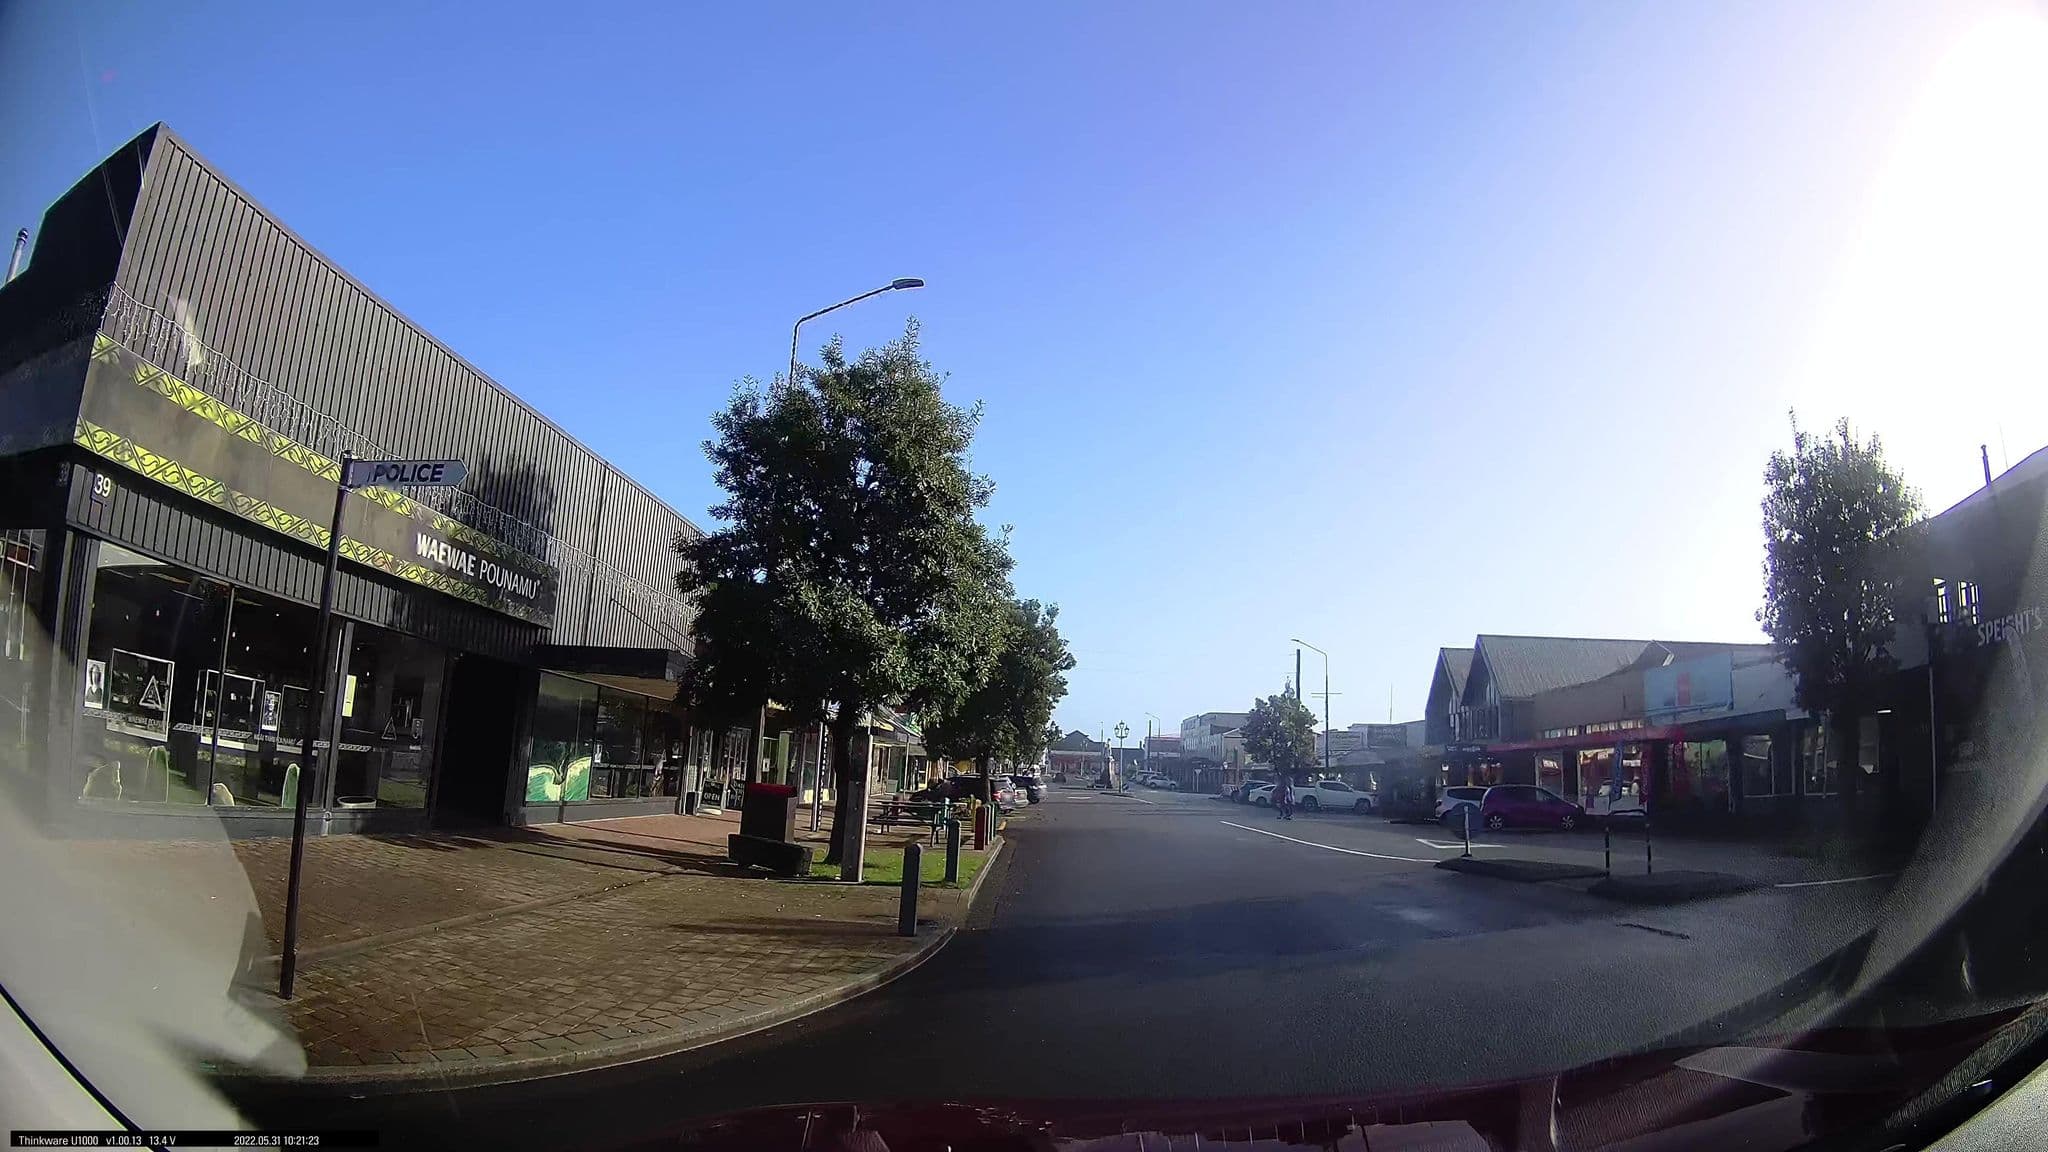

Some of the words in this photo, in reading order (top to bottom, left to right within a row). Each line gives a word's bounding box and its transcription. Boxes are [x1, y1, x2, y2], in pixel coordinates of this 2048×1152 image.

[373, 463, 444, 482] POLICE
[94, 473, 111, 497] 39
[416, 532, 477, 577] WAEWAE
[479, 559, 538, 600] POUNAMU
